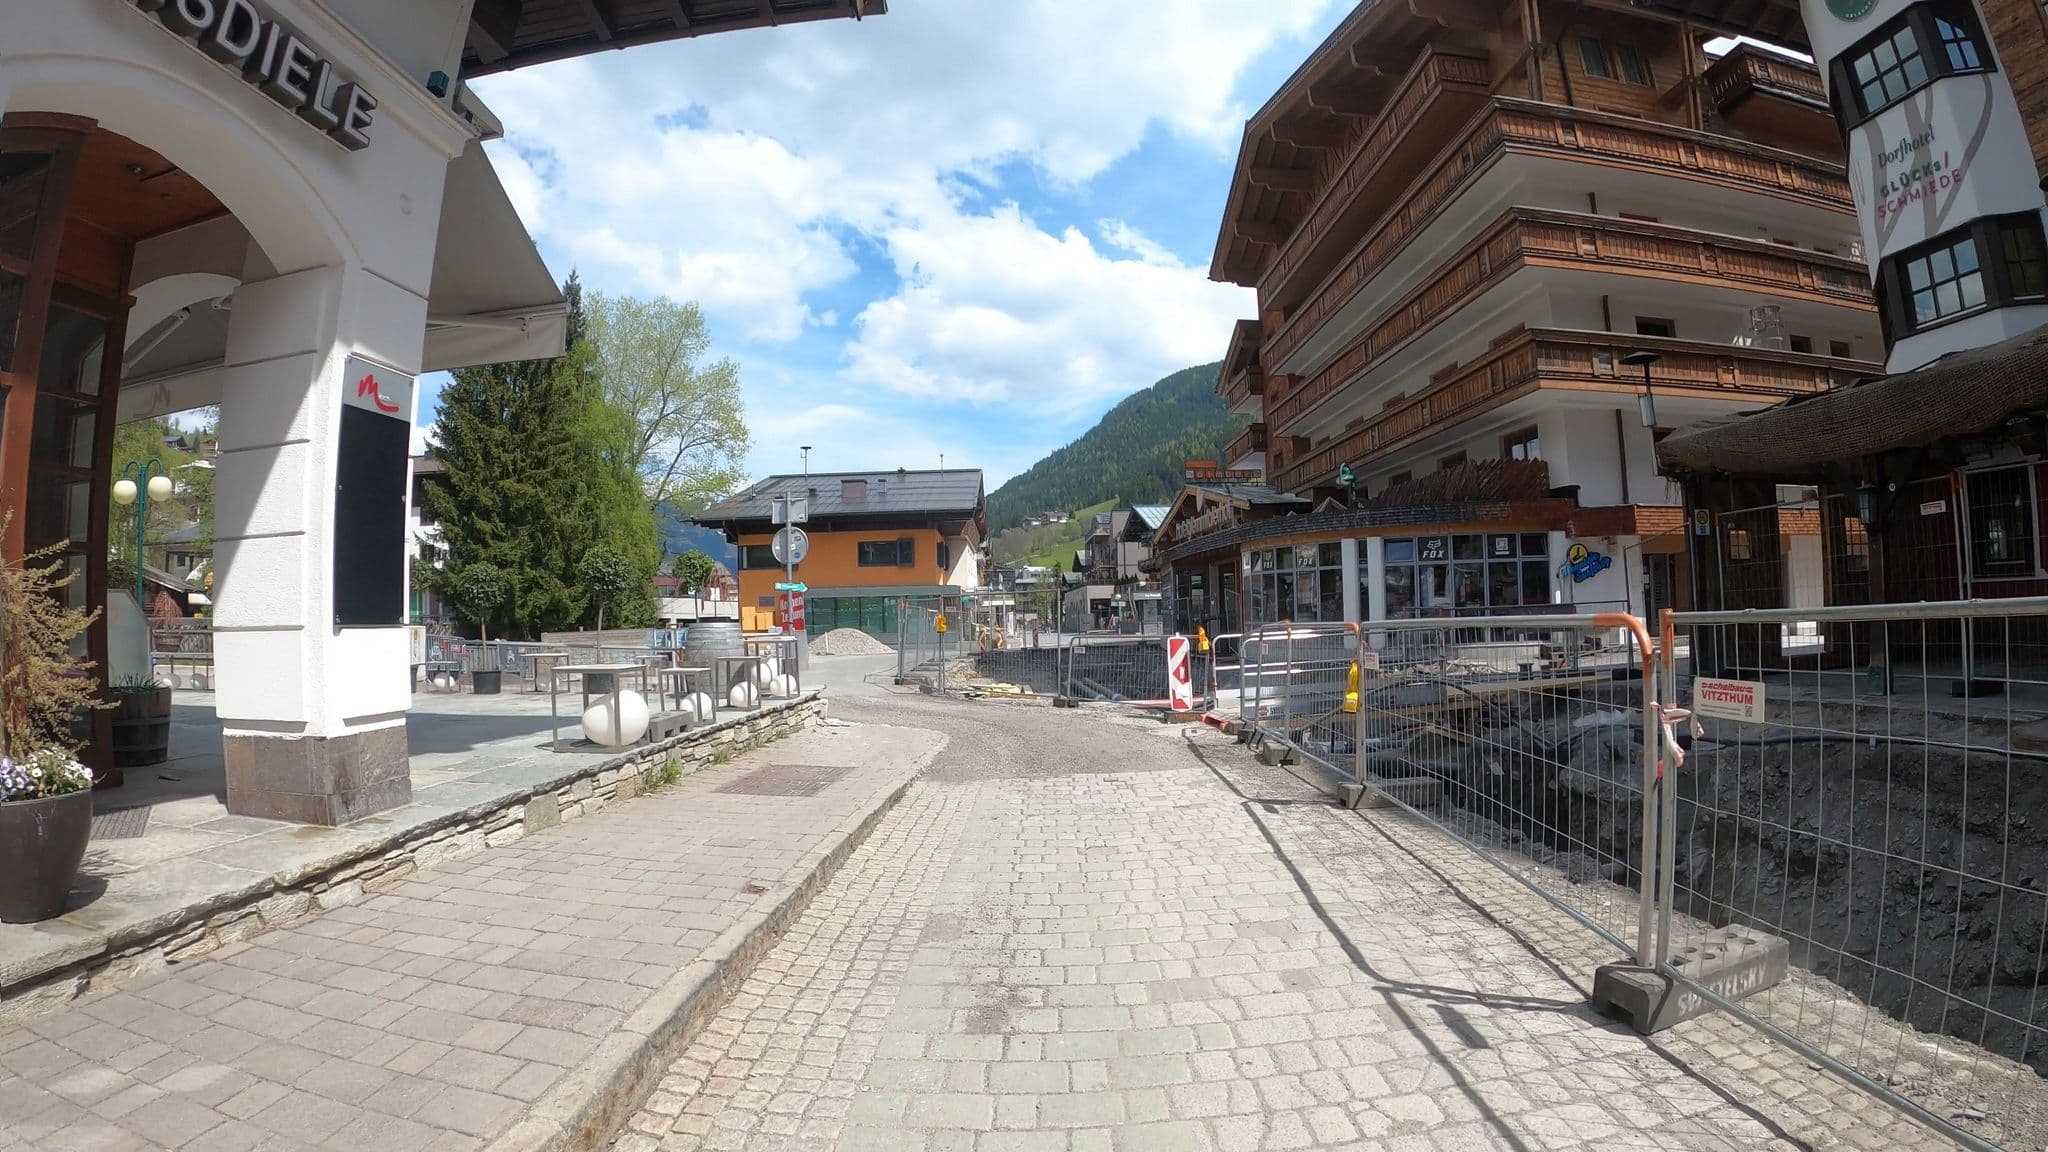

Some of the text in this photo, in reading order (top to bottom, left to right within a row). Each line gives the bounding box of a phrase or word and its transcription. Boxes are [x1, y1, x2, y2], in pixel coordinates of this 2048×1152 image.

[1878, 123, 1935, 168] Dorfhotel
[1877, 168, 1962, 218] SCHMIEDE
[1298, 557, 1313, 566] FOX
[1422, 550, 1445, 559] FOX
[1701, 690, 1753, 705] VITZTHUM
